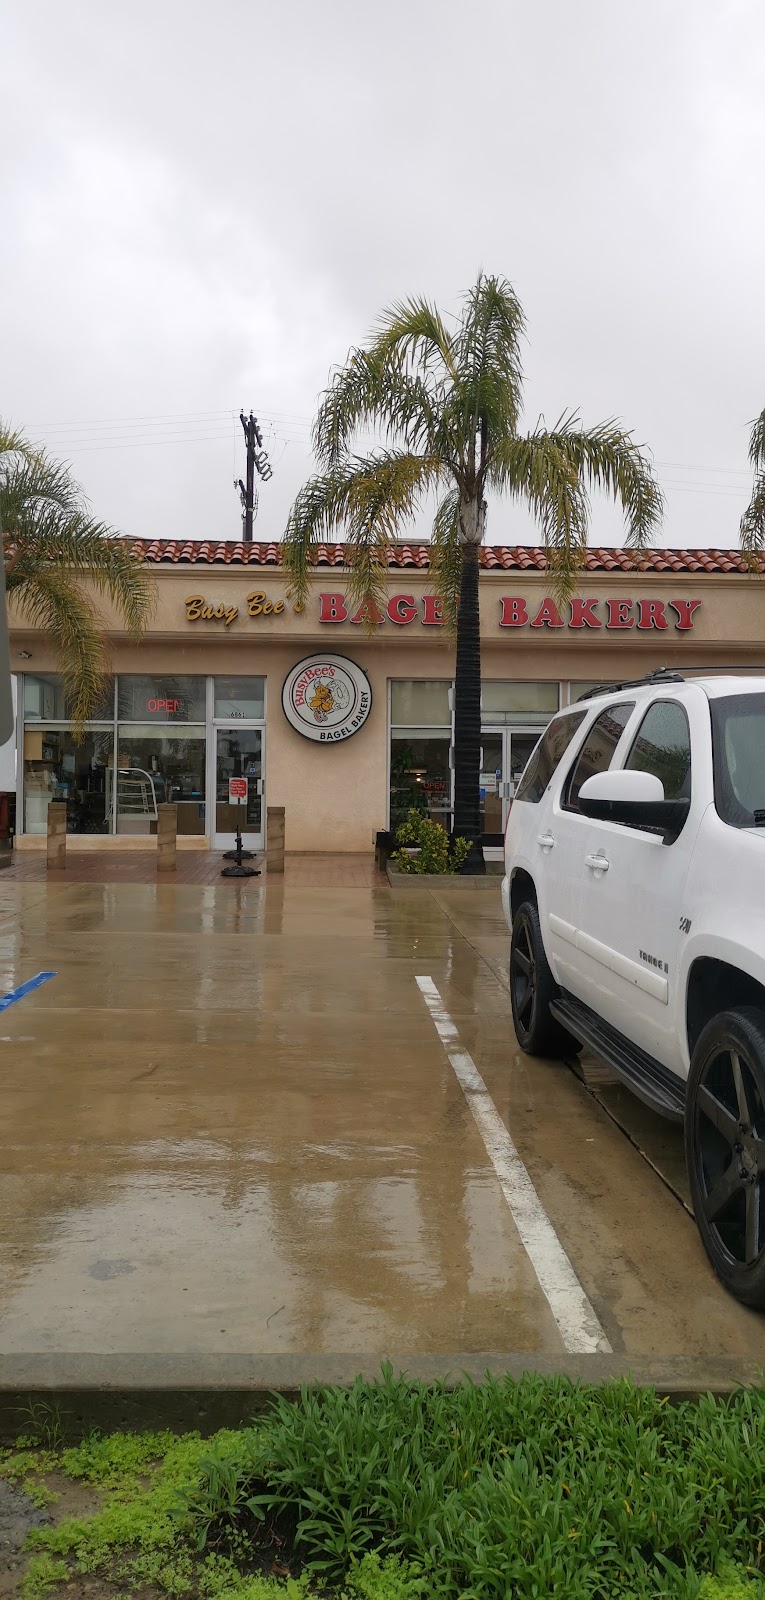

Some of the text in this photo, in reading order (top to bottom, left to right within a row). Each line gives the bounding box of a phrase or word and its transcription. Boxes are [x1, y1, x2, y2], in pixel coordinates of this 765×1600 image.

[185, 594, 239, 626] Busy
[319, 593, 702, 630] BAGE BAKERY
[320, 691, 368, 740] BAGEL BAKERY
[423, 782, 445, 790] OPEN
[639, 949, 663, 970] TAHOE
